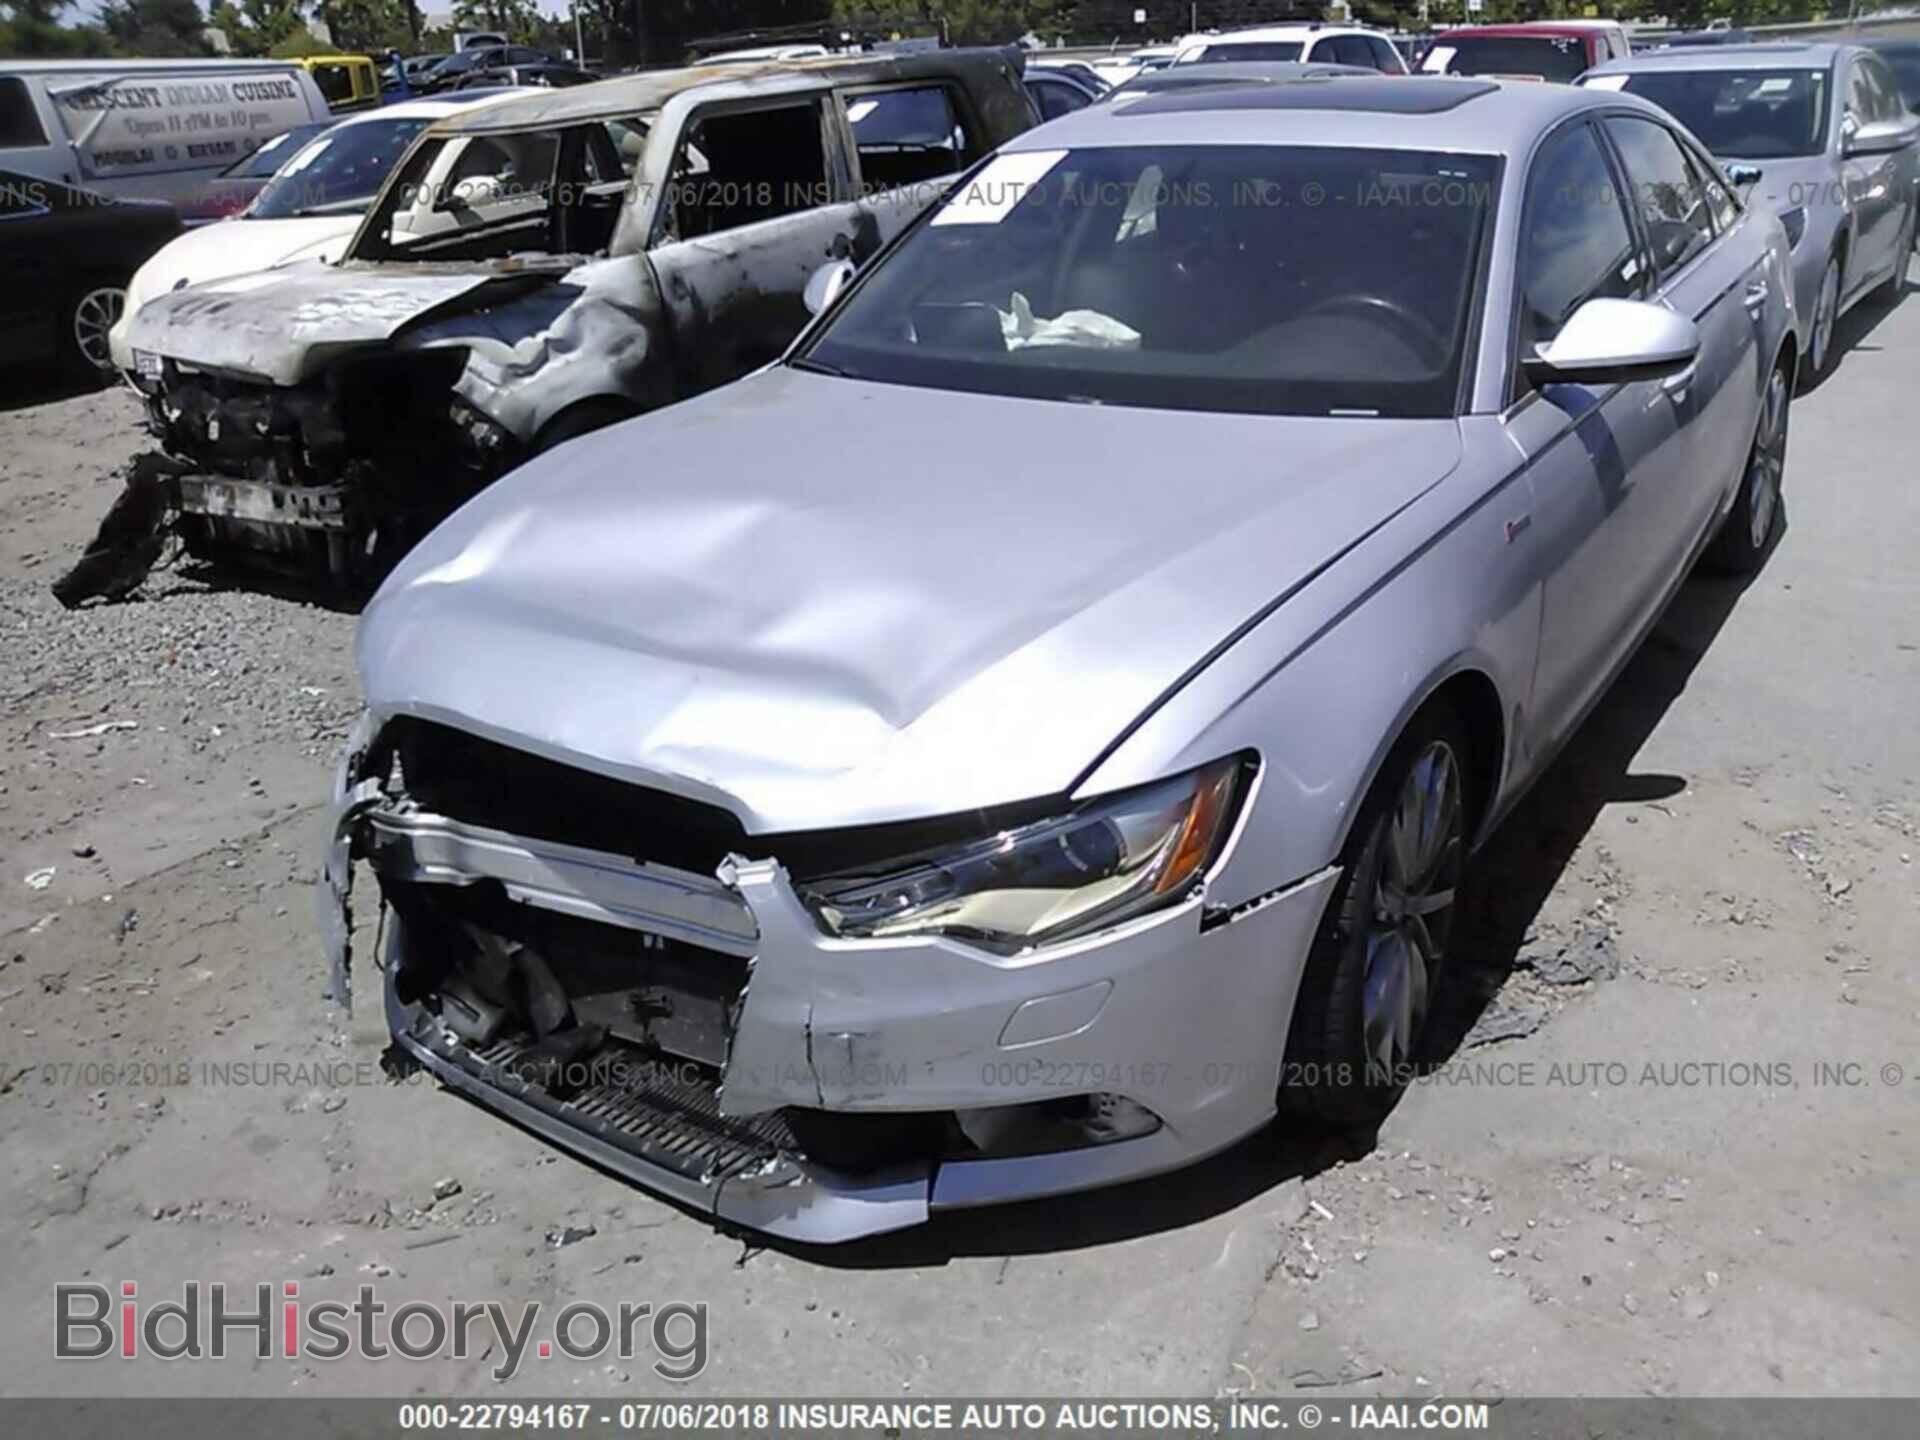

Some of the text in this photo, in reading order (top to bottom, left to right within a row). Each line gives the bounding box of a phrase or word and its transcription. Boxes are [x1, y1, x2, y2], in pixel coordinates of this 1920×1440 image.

[166, 84, 230, 107] INDIAN
[233, 81, 296, 102] CUISINE
[167, 114, 182, 132] 11
[230, 109, 248, 128] 10
